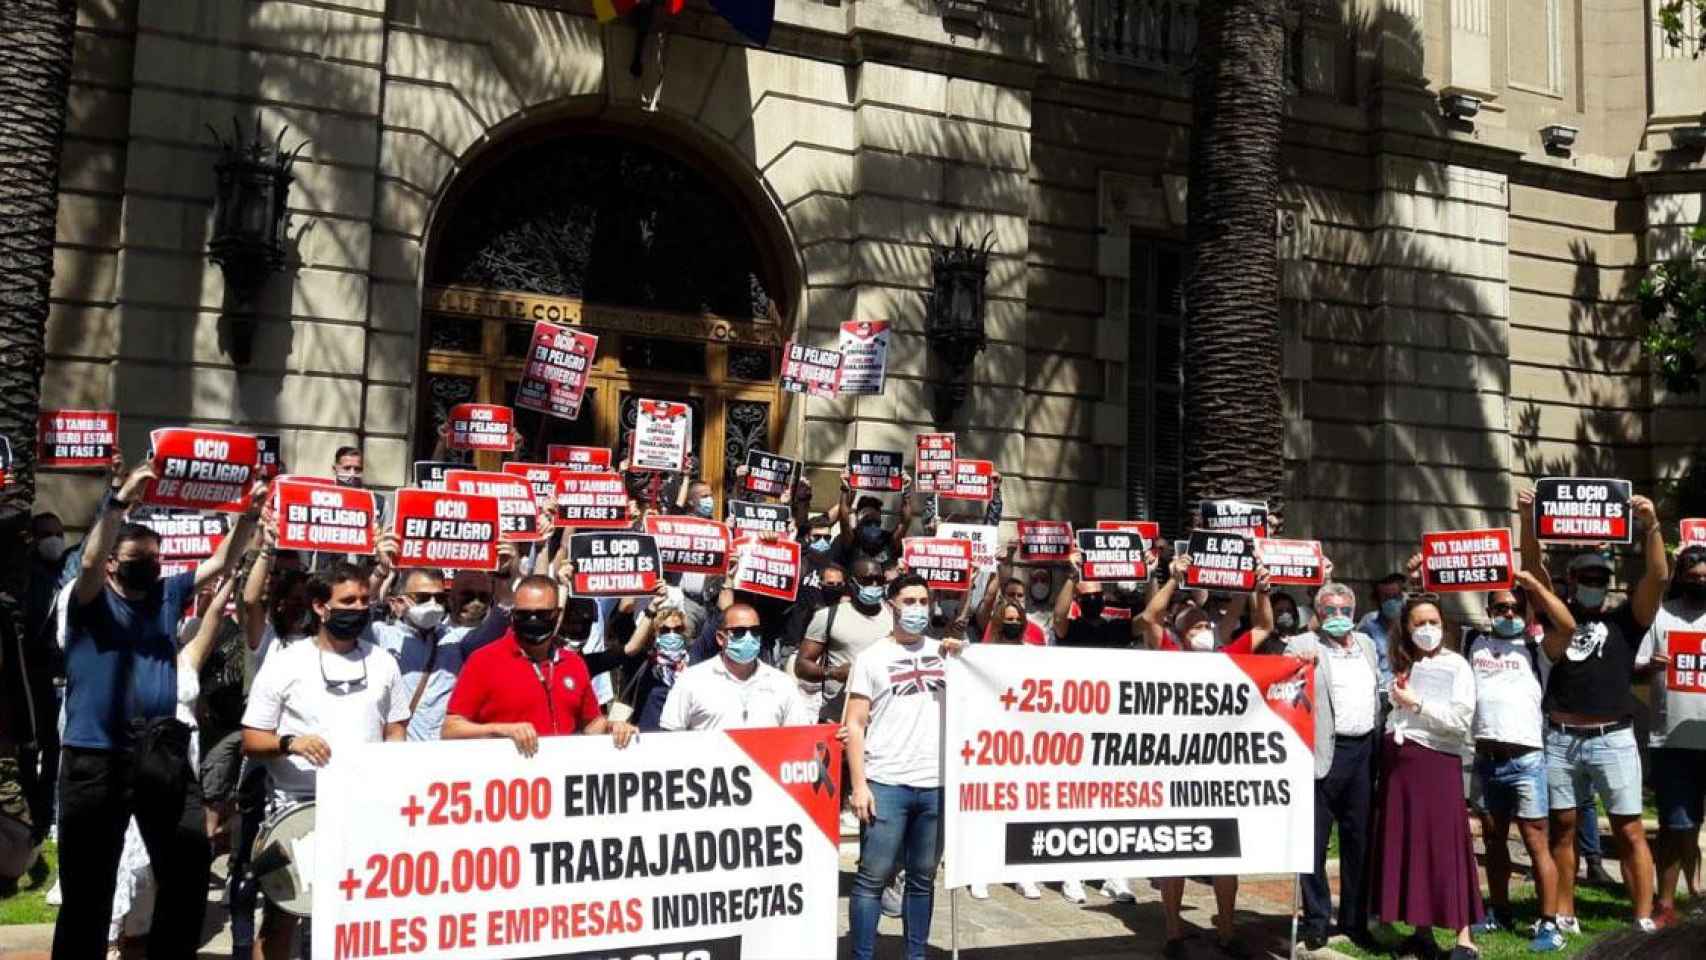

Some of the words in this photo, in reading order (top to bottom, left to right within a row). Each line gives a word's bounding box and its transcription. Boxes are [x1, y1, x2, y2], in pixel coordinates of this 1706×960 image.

[554, 335, 575, 351] OCIO
[535, 345, 549, 360] EN
[548, 349, 586, 371] PELIGRO
[791, 346, 803, 359] EN
[804, 347, 840, 368] PELIGRO
[529, 361, 545, 377] DE
[544, 364, 582, 387] QUIEBRA
[787, 361, 800, 376] DE
[800, 363, 836, 384] QUIEBRA
[472, 408, 492, 420] OCIO
[66, 417, 108, 430] TAMBIÉN
[455, 421, 467, 431] EN
[469, 421, 508, 433] PELIGRO
[46, 432, 80, 444] QUIERO
[82, 432, 112, 444] ESTAR
[468, 433, 508, 446] QUIEBRA
[56, 445, 68, 457] EN
[70, 445, 95, 457] FASE
[97, 446, 104, 457] 3
[194, 438, 229, 460] OCIO
[569, 452, 590, 462] OCIO
[929, 450, 952, 460] PELIGRO
[761, 457, 770, 469] EL
[772, 460, 791, 473] OCIO
[861, 454, 871, 464] EL
[873, 455, 891, 465] OCIO
[164, 458, 187, 475] EN
[190, 461, 250, 484] PELIGRO
[432, 468, 442, 479] EL
[527, 471, 550, 482] OCIO
[852, 464, 887, 476] TAMBIÉN
[889, 466, 899, 477] ES
[565, 480, 578, 493] YO
[580, 478, 624, 493] TAMBIÉN
[857, 477, 892, 488] CULTURA
[957, 475, 987, 485] PELIGRO
[156, 479, 178, 497] DE
[181, 482, 241, 502] QUIEBRA
[458, 481, 475, 493] YO
[478, 481, 529, 498] TAMBIÉN
[1557, 485, 1573, 500] EL
[1577, 485, 1608, 501] OCIO
[311, 491, 342, 507] OCIO
[559, 494, 594, 507] QUIERO
[596, 495, 628, 507] ESTAR
[435, 500, 468, 518] OCIO
[501, 501, 536, 516] ESTAR
[567, 507, 582, 519] EN
[584, 508, 607, 519] FASE
[609, 508, 617, 519] 3
[745, 507, 756, 518] EL
[757, 508, 778, 520] OCIO
[1216, 503, 1228, 515] EL
[1543, 499, 1602, 517] TAMBIÉN
[1605, 502, 1622, 517] ES
[288, 505, 308, 522] EN
[311, 508, 368, 528] PELIGRO
[518, 518, 527, 531] 3
[736, 516, 773, 530] TAMBIÉN
[774, 519, 786, 531] ES
[1208, 515, 1247, 528] TAMBIÉN
[1249, 514, 1262, 527] ES
[203, 520, 221, 535] ES
[406, 519, 428, 536] EN
[430, 521, 492, 541] PELIGRO
[656, 521, 671, 534] YO
[673, 522, 721, 537] TAMBIÉN
[1552, 518, 1611, 535] CULTURA
[287, 524, 306, 541] DE
[309, 526, 368, 546] QUIEBRA
[1023, 535, 1047, 544] QUIERO
[1048, 536, 1070, 545] ESTAR
[1095, 535, 1107, 549] EL
[1108, 535, 1130, 549] OCIO
[402, 541, 423, 558] DE
[426, 543, 490, 561] QUIEBRA
[591, 539, 606, 555] EL
[609, 539, 640, 556] OCIO
[656, 535, 691, 550] UIERO
[693, 537, 726, 552] ESTAR
[914, 543, 926, 555] YO
[927, 542, 965, 556] TAMBIÉN
[1029, 545, 1038, 553] EN
[1039, 545, 1056, 554] FASE
[1206, 537, 1218, 552] EL
[1221, 538, 1244, 554] OCIO
[1431, 542, 1447, 555] YO
[1449, 534, 1500, 553] TAMBIÉN
[661, 551, 675, 563] EN
[677, 552, 705, 564] FASE
[707, 554, 715, 565] 3
[908, 555, 940, 568] QUIERO
[941, 557, 969, 570] ESTAR
[1085, 547, 1127, 562] TAMBIÉN
[1128, 550, 1141, 562] ES
[1193, 551, 1238, 569] TAMBIÉN
[1239, 556, 1254, 570] ES
[1427, 555, 1469, 571] QUIERO
[1471, 553, 1507, 568] ESTAR
[577, 554, 634, 573] TAMBIÉN
[637, 555, 654, 572] ES
[767, 561, 796, 573] ESTAR
[1093, 563, 1136, 578] CULTURA
[1270, 565, 1282, 577] EN
[1283, 566, 1304, 578] FASE
[1306, 567, 1313, 578] 3
[587, 573, 645, 592] CULTURA
[756, 570, 777, 584] FASE
[779, 576, 787, 588] 3
[930, 570, 952, 582] FASE
[953, 572, 960, 582] 3
[1198, 567, 1245, 585] CULTURA
[1440, 570, 1456, 584] EN
[1458, 568, 1487, 583] FASE
[1490, 568, 1498, 582] 3
[1677, 654, 1695, 670] EN
[1676, 671, 1695, 687] DE
[999, 679, 1111, 715] +25.000
[1118, 680, 1250, 716] EMPRESAS
[960, 730, 1084, 767] +200.000
[1091, 730, 1287, 766] TRABAJADORES
[400, 776, 553, 828] +25.000
[564, 764, 752, 817] EMPRESAS
[780, 760, 820, 784] OCIO
[959, 782, 1018, 812] MILES
[1025, 781, 1050, 810] DE
[1057, 779, 1163, 809] EMPRESAS
[1170, 778, 1291, 807] INDIRECTAS
[1031, 824, 1213, 858] #OCIOFASE3
[338, 845, 520, 902] +200.000
[530, 823, 803, 887] TRABAJADORES
[334, 915, 427, 960] MILES
[439, 910, 475, 949] DE
[487, 898, 642, 946] EMPRESAS
[652, 882, 804, 931] INDIRECTAS
